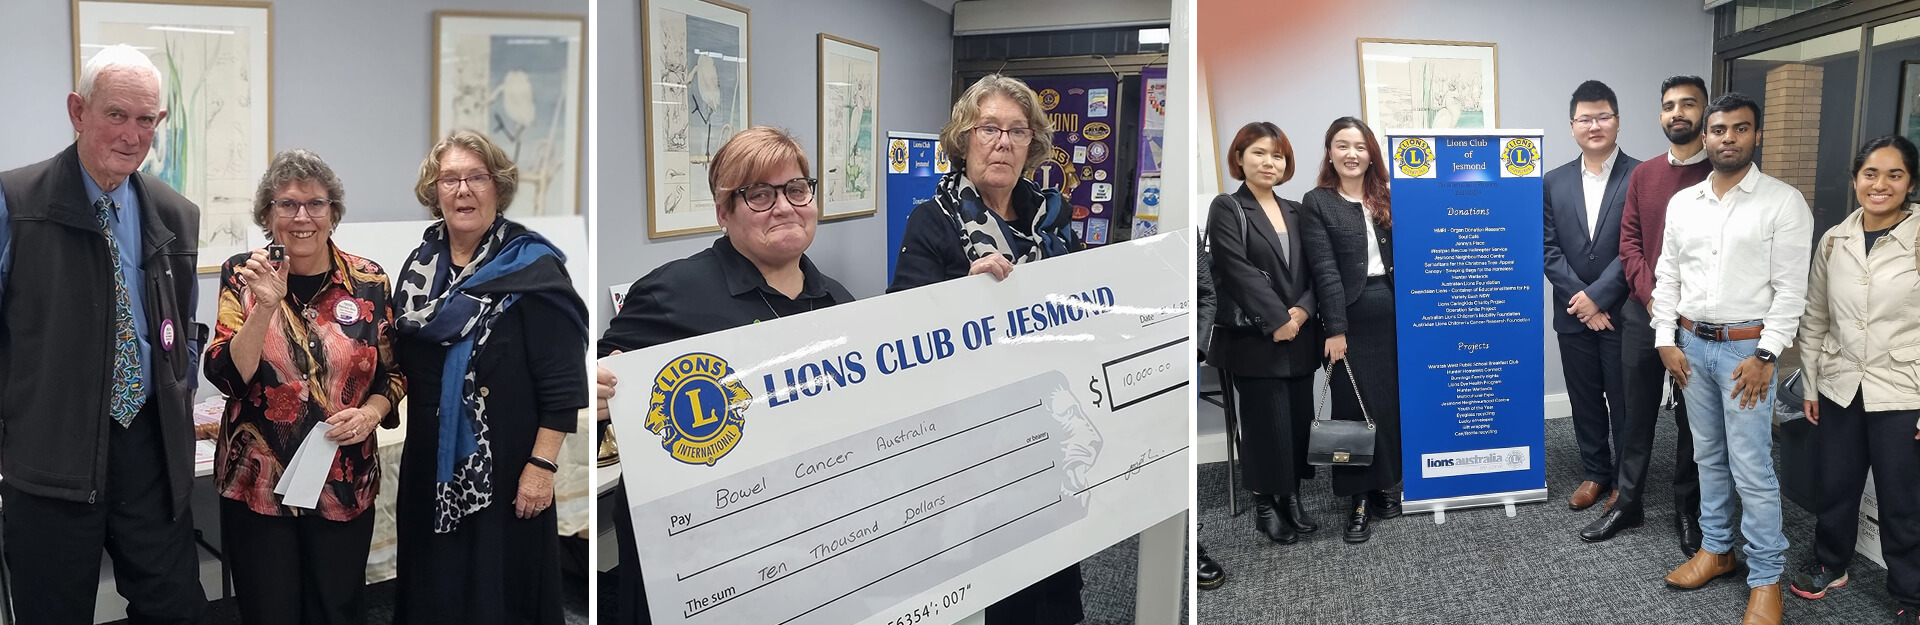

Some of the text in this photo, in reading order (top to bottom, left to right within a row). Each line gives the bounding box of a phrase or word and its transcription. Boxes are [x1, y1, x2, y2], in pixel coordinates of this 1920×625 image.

[1048, 113, 1078, 132] MOND
[1403, 140, 1426, 148] LIONS
[1446, 139, 1488, 147] Lions Club
[1509, 140, 1531, 148] LIONS
[1410, 150, 1420, 164] L
[1516, 150, 1526, 163] L
[1453, 162, 1486, 172] Jesmond
[1447, 207, 1490, 216] Donations
[1140, 314, 1154, 323] Date
[764, 286, 1114, 407] LIONS CLUB OF JESMOND
[1458, 342, 1489, 353] Projects
[661, 358, 722, 387] LIONS
[1090, 376, 1102, 408] $
[686, 388, 718, 428] L
[1032, 432, 1047, 442] bearer
[677, 431, 736, 458] INTERNATIONAL
[1427, 453, 1502, 467] lions australia
[671, 421, 936, 527] Pay Bowel Cancer Australia
[686, 495, 945, 613] The sum Ten Thousand Dollars
